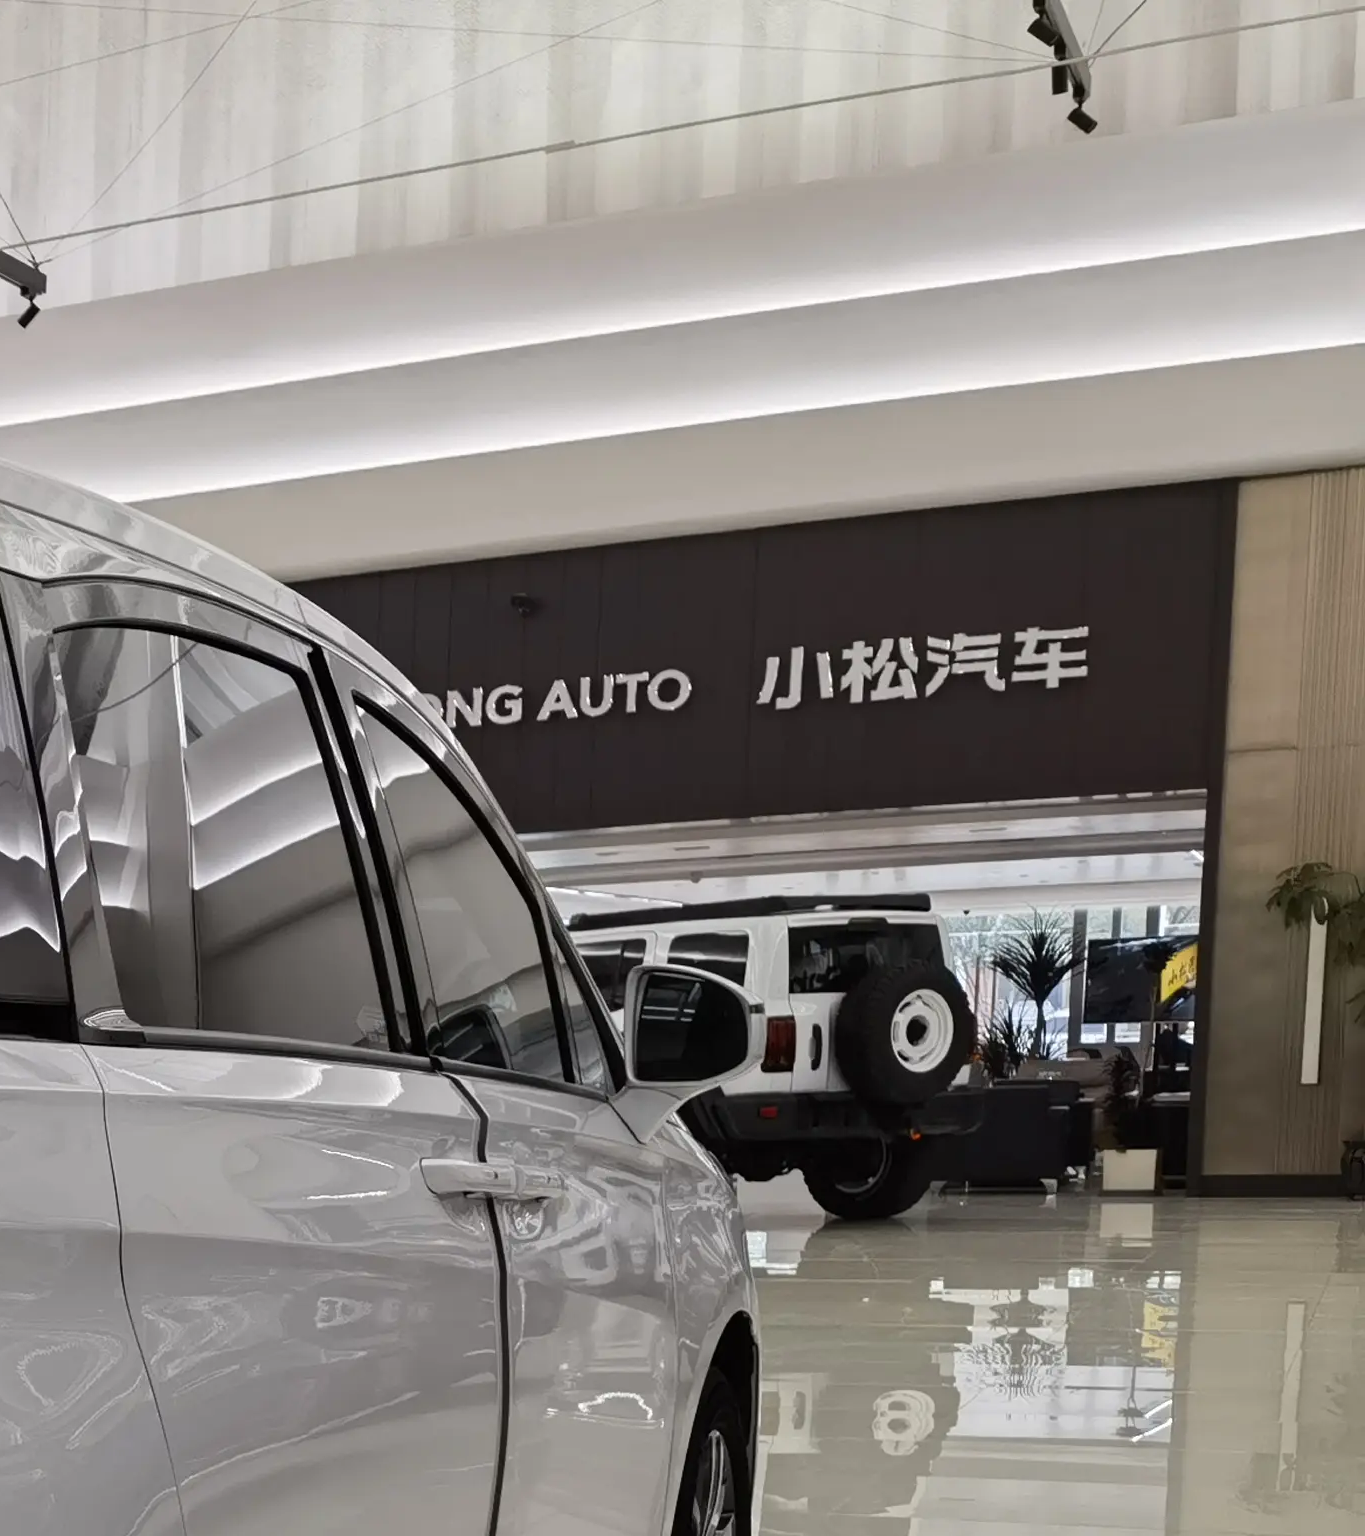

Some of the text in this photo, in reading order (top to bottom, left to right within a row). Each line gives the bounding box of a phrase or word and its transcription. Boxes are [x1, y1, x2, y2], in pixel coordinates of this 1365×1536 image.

[536, 669, 692, 722] AUTO
[756, 627, 1089, 710] 小松汽车
